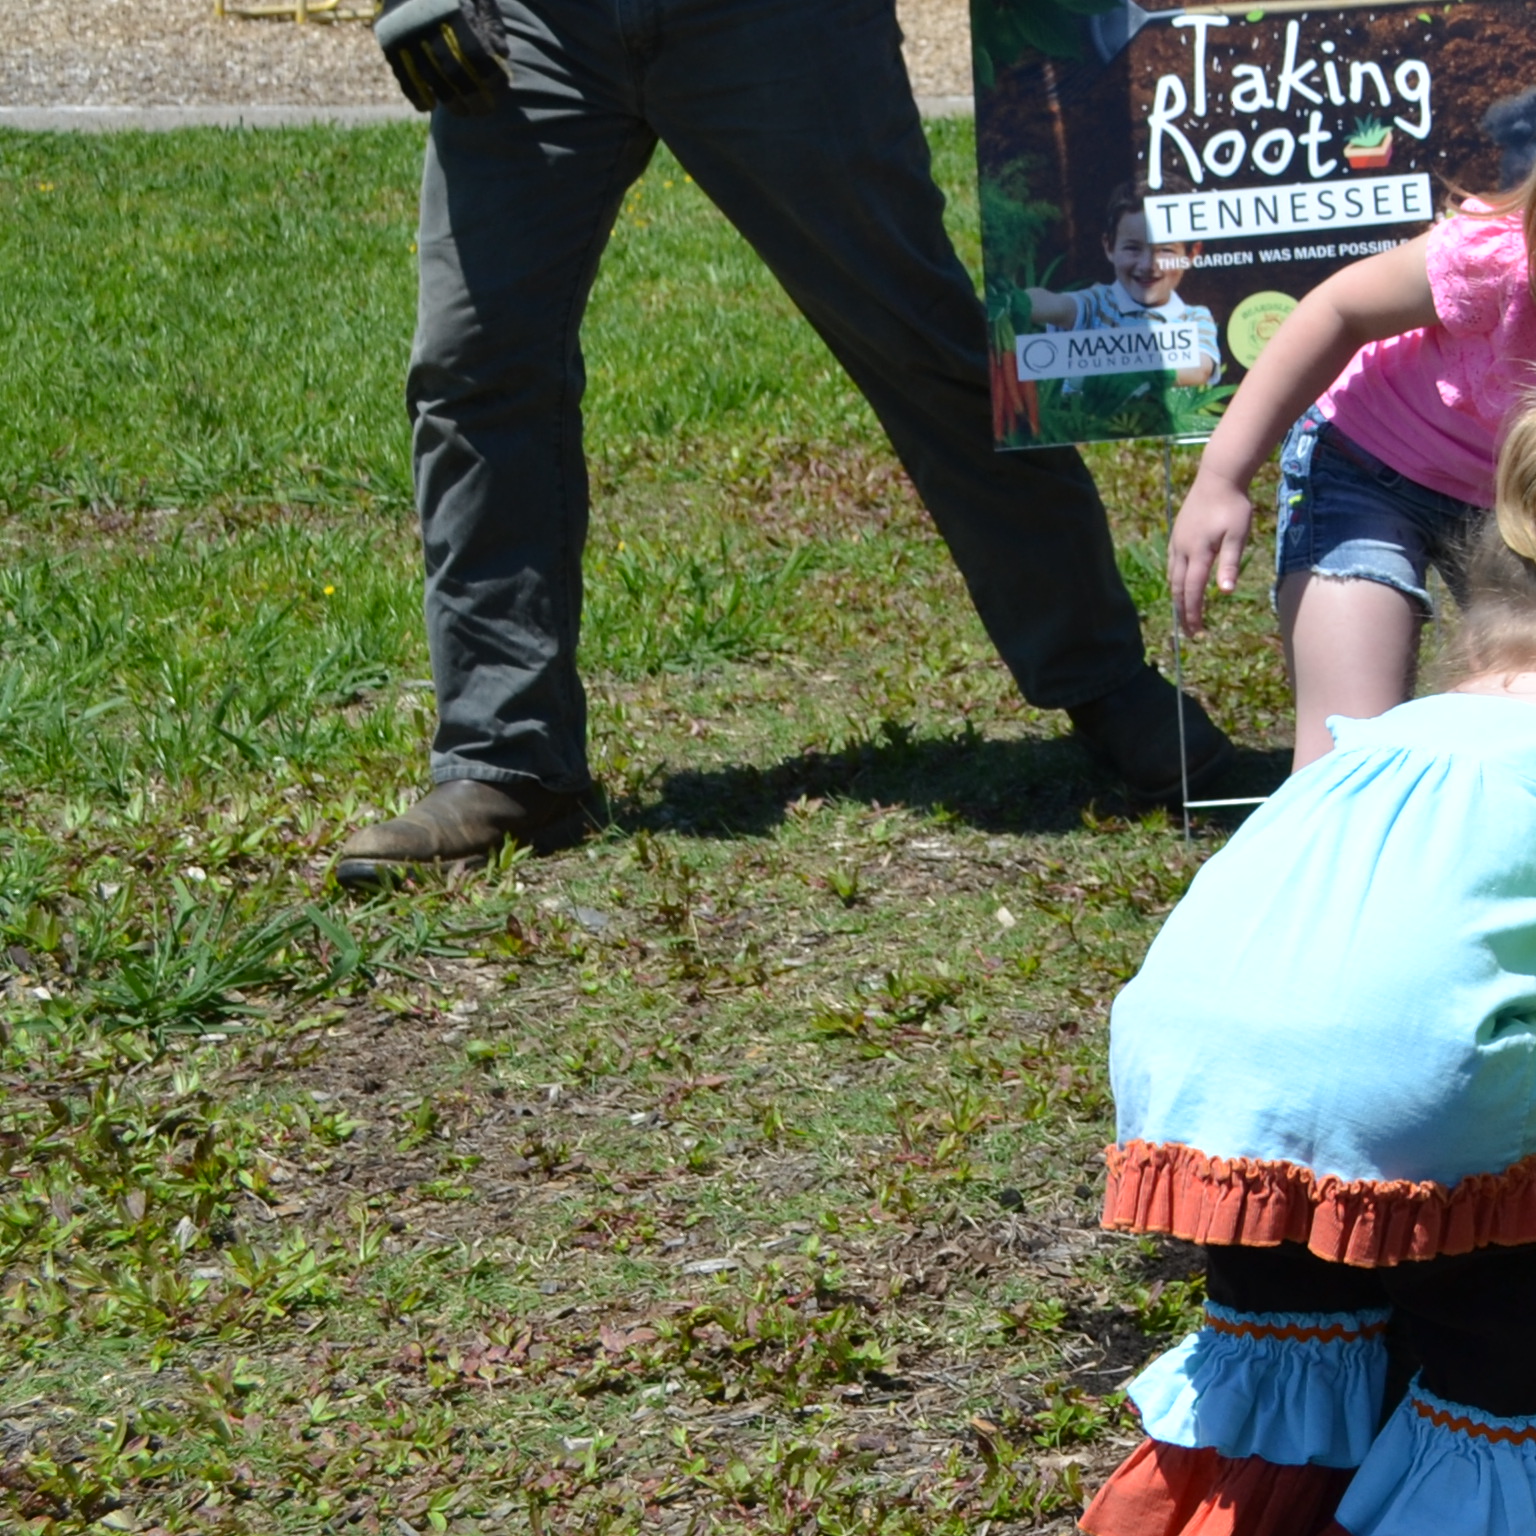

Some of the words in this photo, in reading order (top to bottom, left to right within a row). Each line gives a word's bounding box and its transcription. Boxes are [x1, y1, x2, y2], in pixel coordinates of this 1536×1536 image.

[1172, 15, 1432, 139] Taking
[1148, 74, 1338, 189] Root
[1157, 182, 1422, 234] TENNESSEE
[1157, 257, 1191, 270] THIS
[1193, 251, 1253, 268] GARDEN
[1259, 247, 1292, 263] WAS
[1294, 244, 1337, 260] MADE
[1068, 329, 1193, 358] MAXIMUS
[1068, 351, 1192, 369] FOUNDATION
